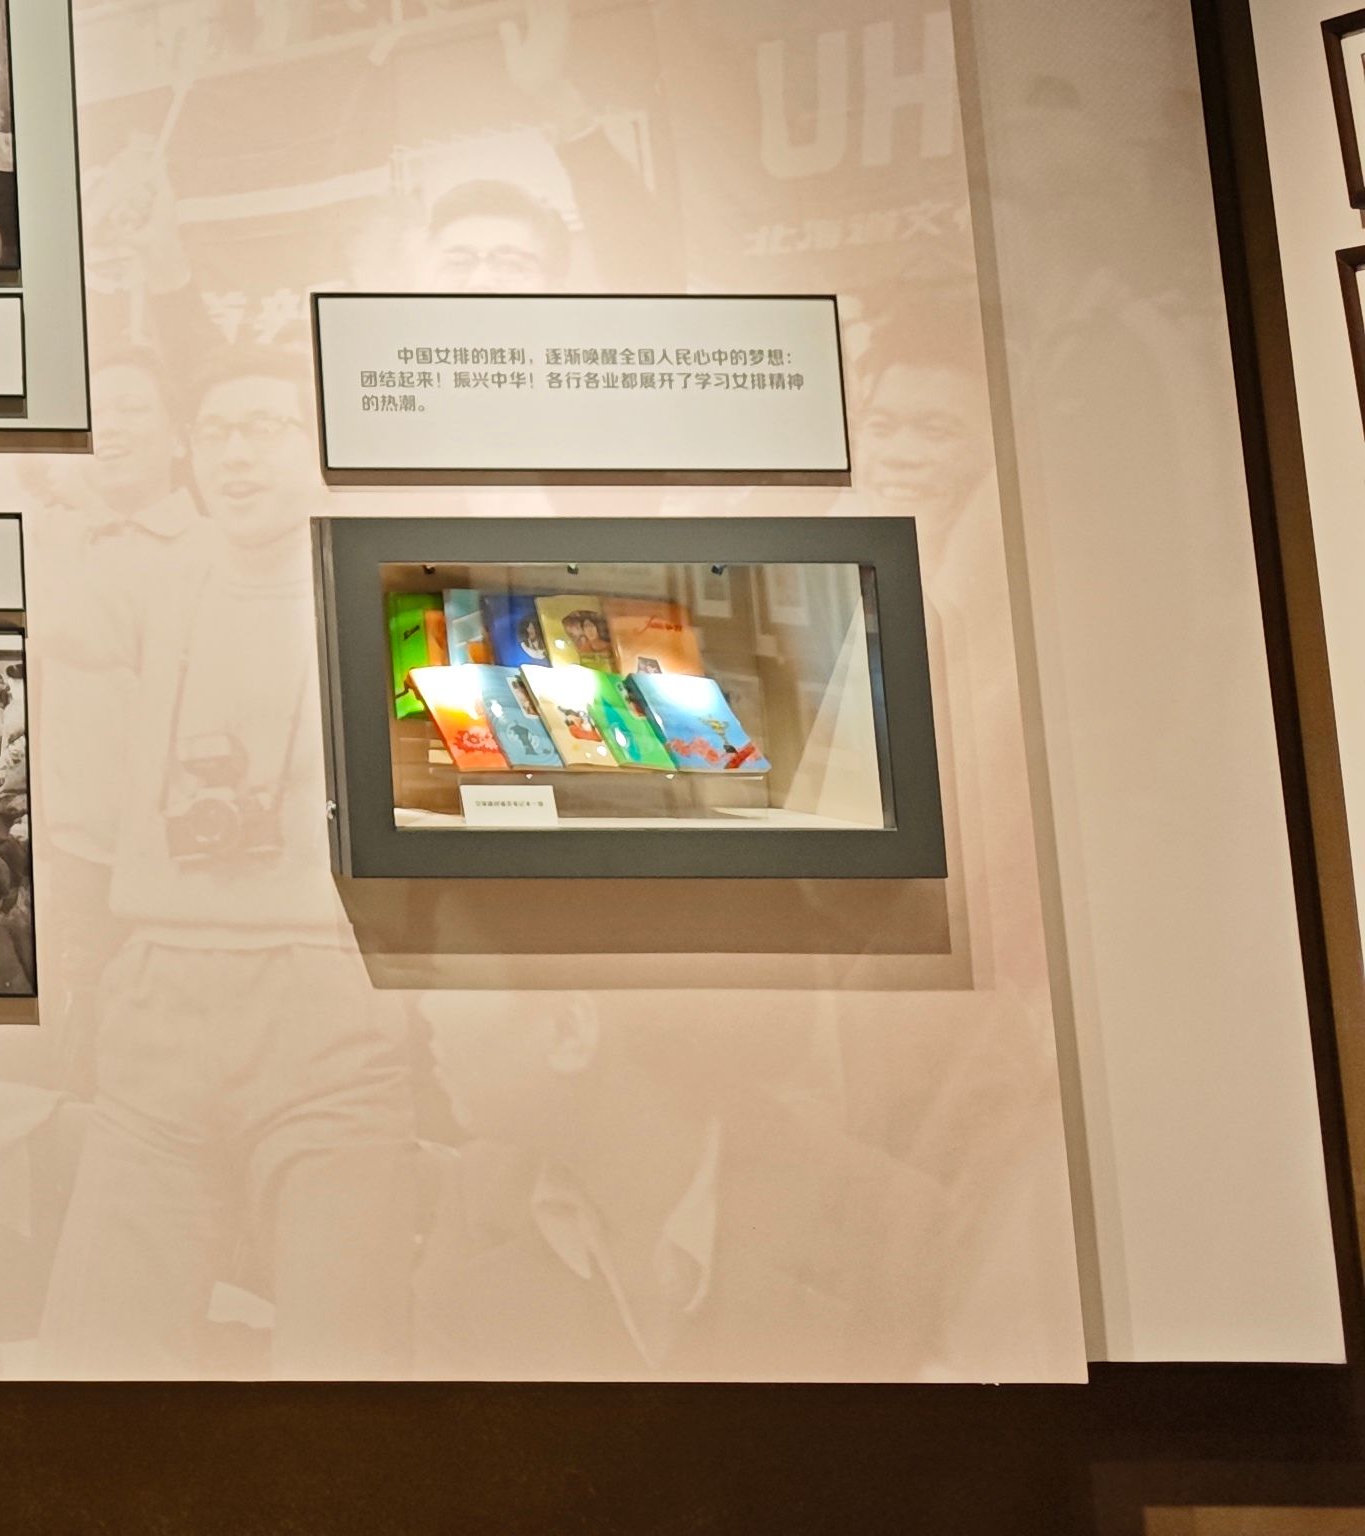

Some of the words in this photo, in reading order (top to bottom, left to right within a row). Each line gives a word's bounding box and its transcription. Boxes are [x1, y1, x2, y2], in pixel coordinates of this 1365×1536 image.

[397, 347, 791, 366] 中国女排的胜利，逐渐唤醒全国人民心中的梦想：
[361, 371, 804, 390] 团结起来！振兴中华！各行各业都展开了学习女排精神
[362, 394, 425, 412] 的热潮。
